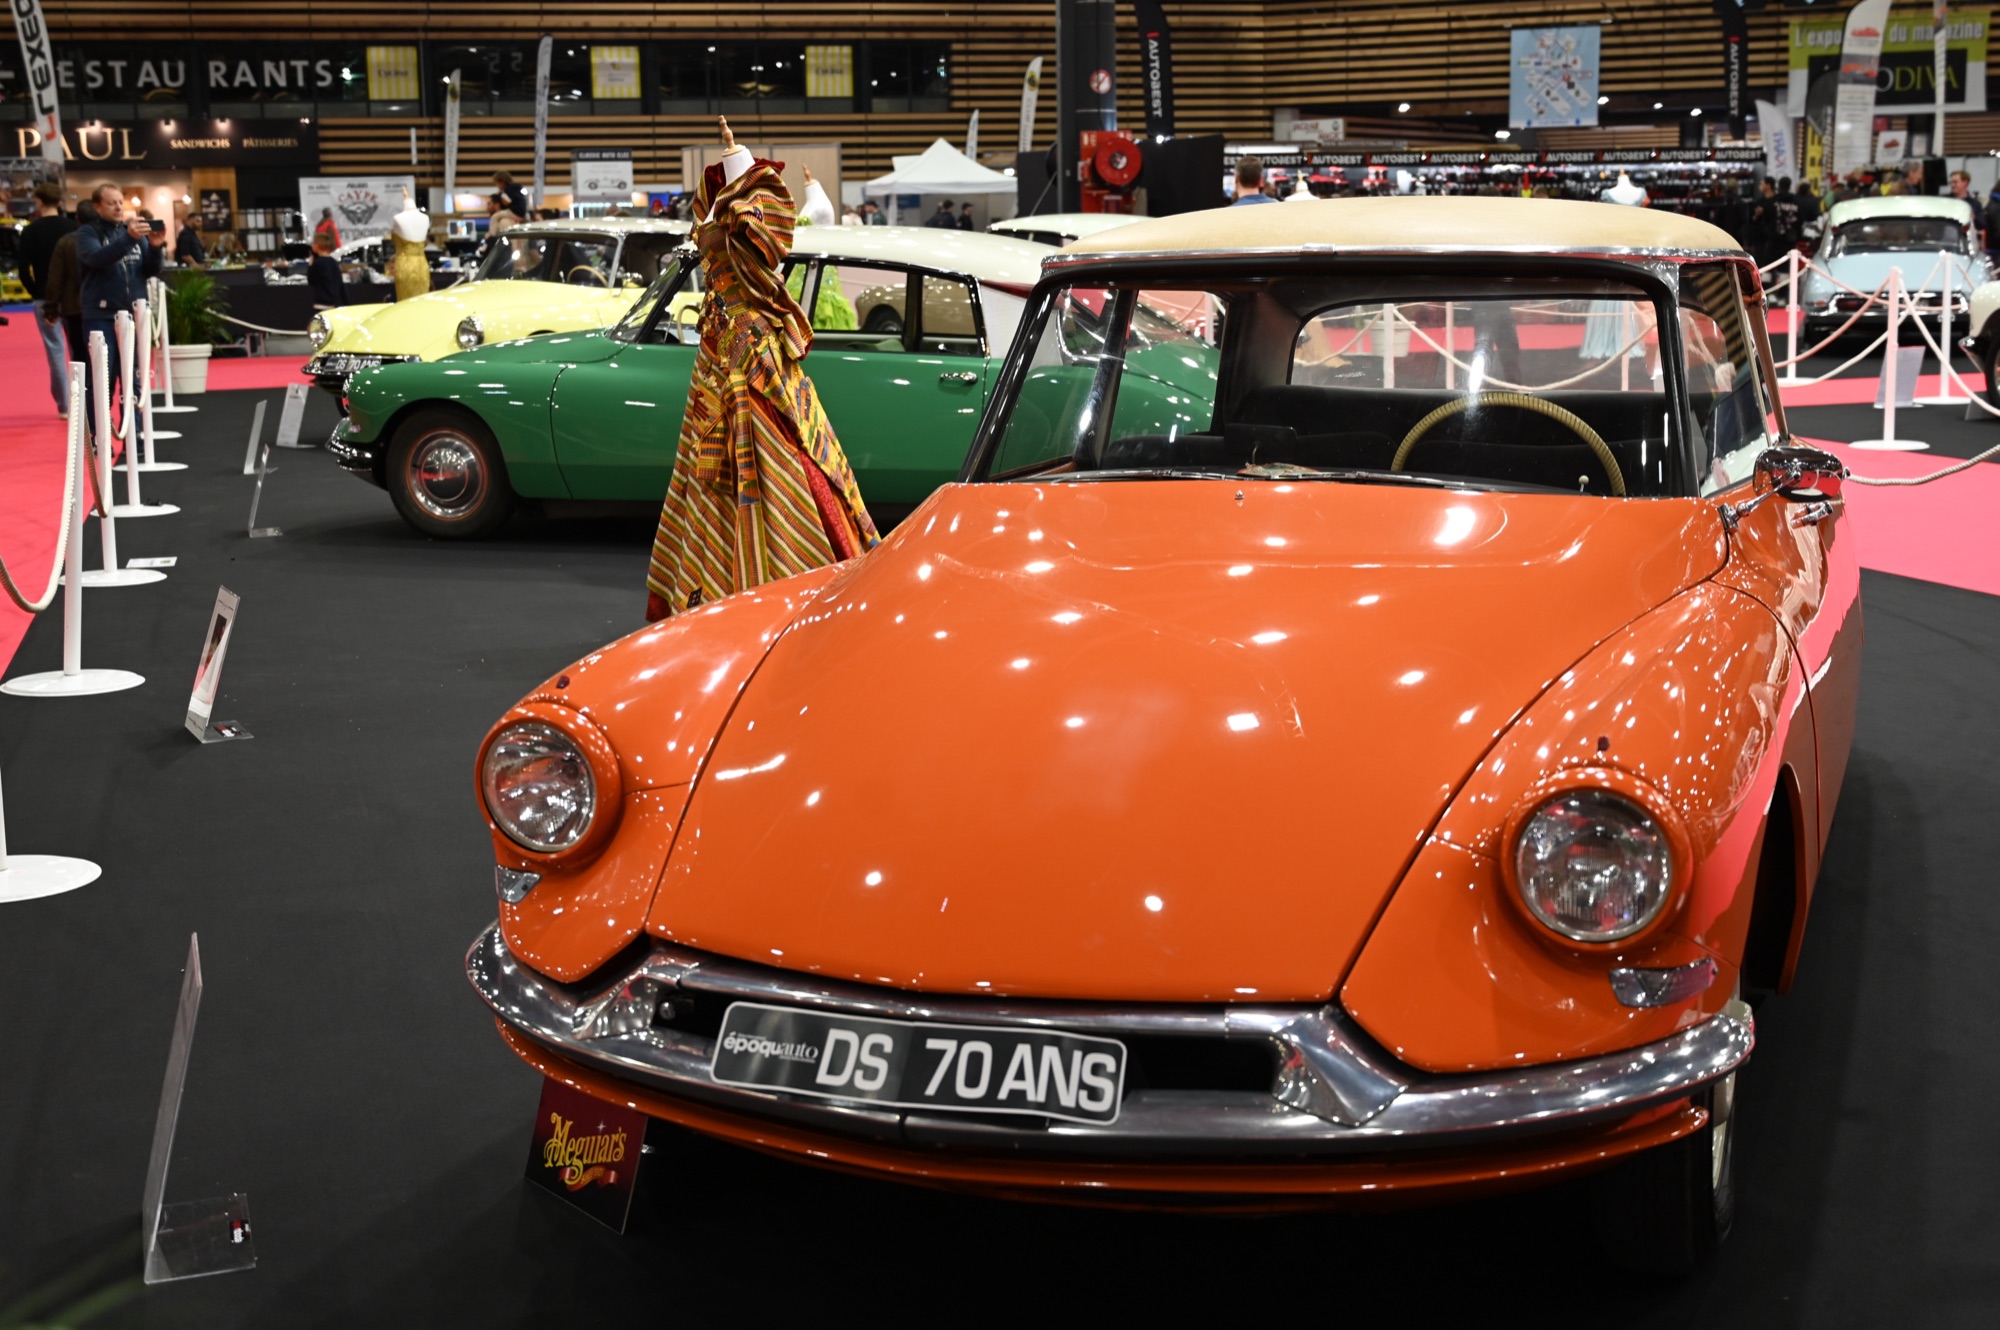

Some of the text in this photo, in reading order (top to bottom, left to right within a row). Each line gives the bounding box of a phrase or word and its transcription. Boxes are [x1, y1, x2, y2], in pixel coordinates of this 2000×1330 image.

[1795, 26, 1842, 49] L'expo
[1890, 22, 1907, 43] du
[1912, 20, 1984, 42] maazine
[1148, 38, 1163, 118] AUTOBEST
[1729, 42, 1739, 117] AUTOBEST
[170, 138, 231, 149] SANDWICHS
[1261, 155, 1303, 165] UTOBEST
[1311, 155, 1363, 165] AUTOBEST
[1371, 154, 1421, 164] AUTOBEST
[1430, 153, 1480, 163] AUTOBEST
[1489, 152, 1537, 162] AUTOBEST
[1546, 152, 1595, 162] AUTOBEST
[1602, 151, 1650, 161] AUTOBEST
[1660, 150, 1706, 160] AUTOBEST
[1714, 150, 1761, 160] AUTOBEST
[335, 359, 380, 370] DS 70 ANS
[816, 1028, 894, 1091] DS
[924, 1038, 993, 1099] 70
[997, 1043, 1118, 1112] ANS
[544, 1112, 627, 1186] Meguiar's
